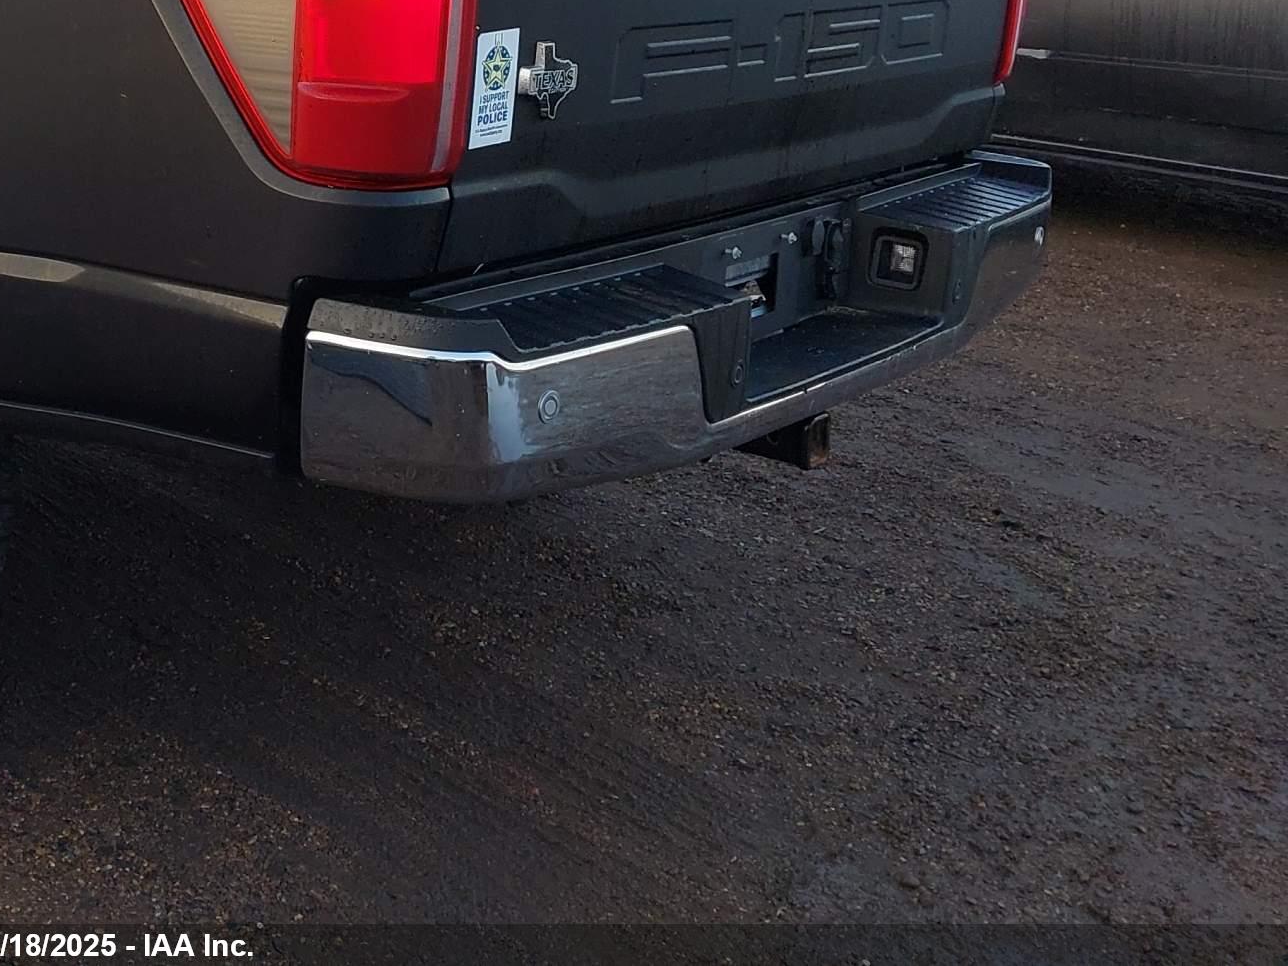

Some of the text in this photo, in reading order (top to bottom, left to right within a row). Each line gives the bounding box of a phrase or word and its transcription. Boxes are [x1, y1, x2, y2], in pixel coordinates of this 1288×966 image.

[532, 68, 574, 90] TEXAS
[482, 90, 509, 104] SUPPORT
[478, 100, 508, 115] MY LOCAL
[477, 110, 508, 126] POLICE
